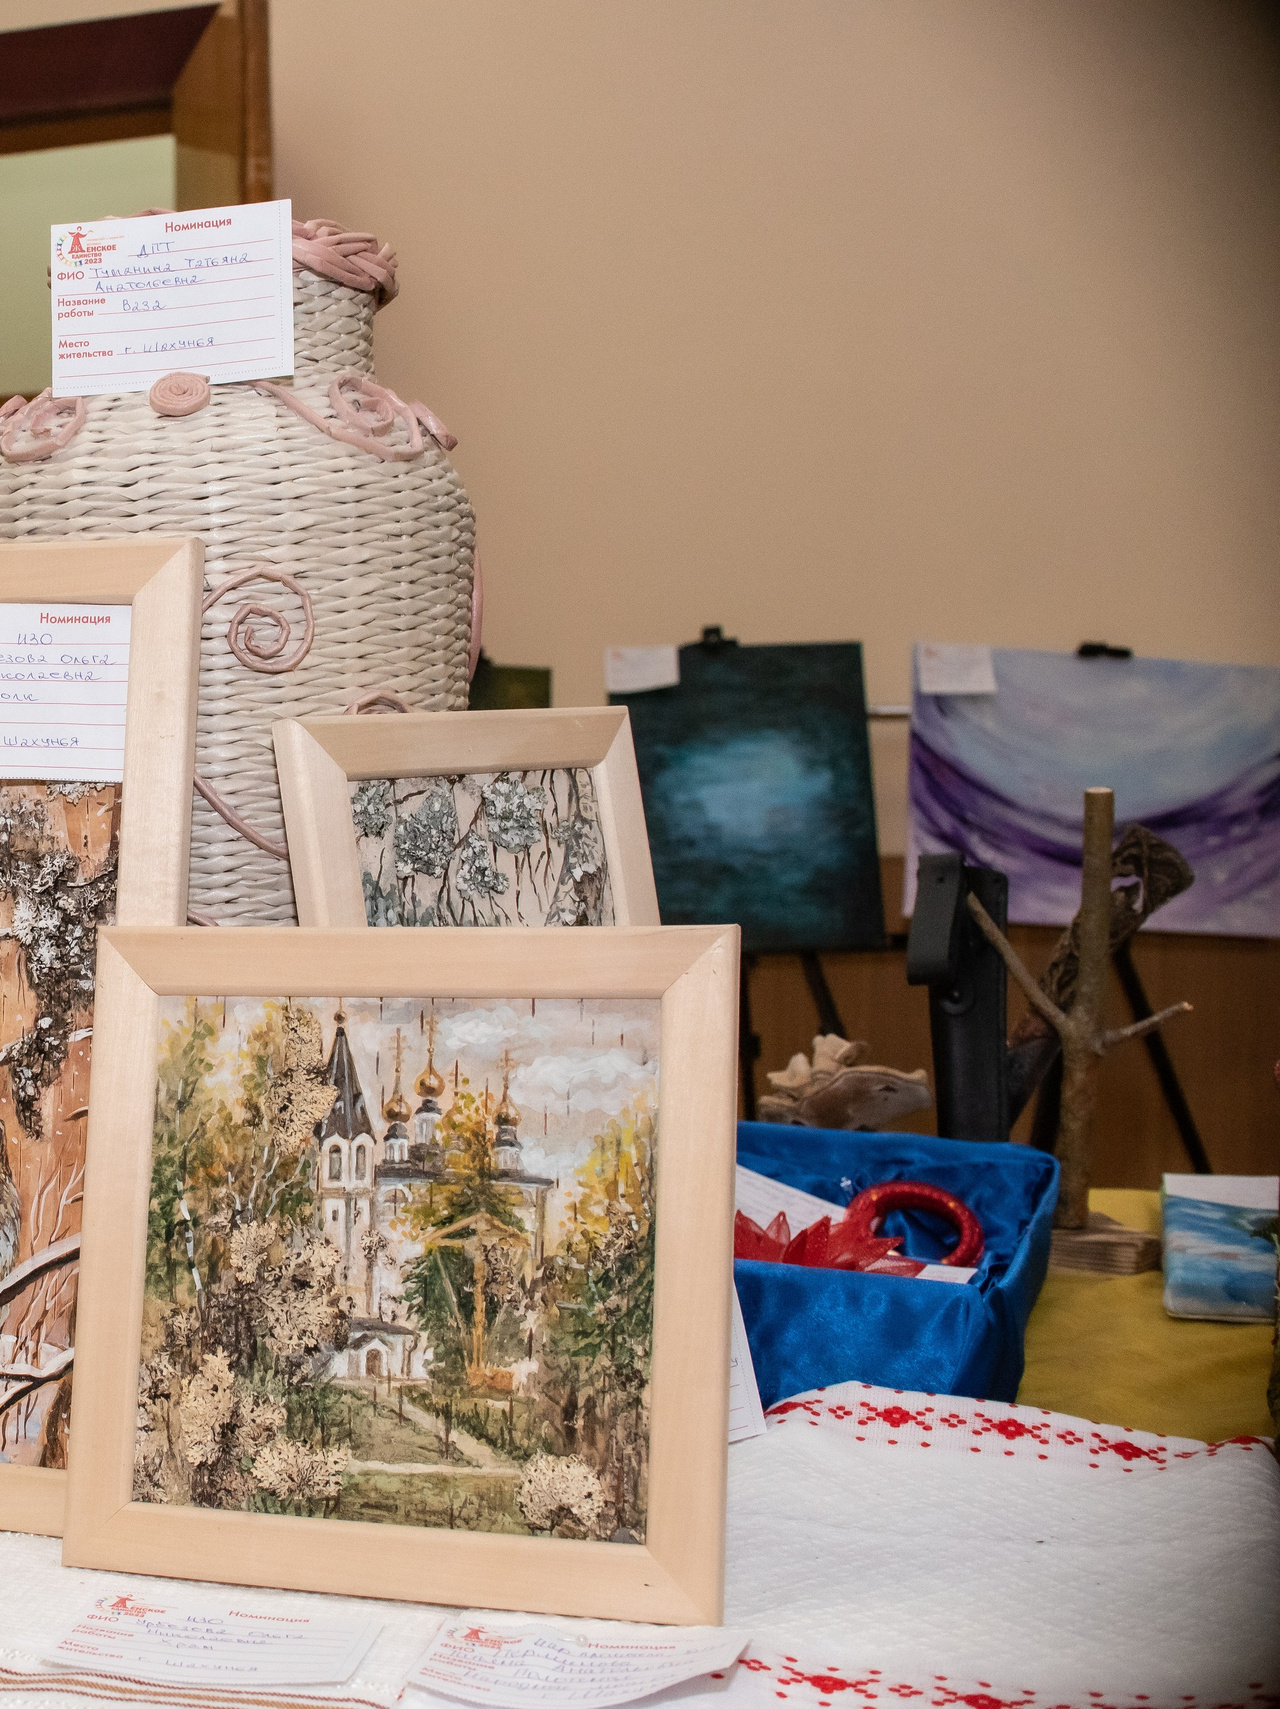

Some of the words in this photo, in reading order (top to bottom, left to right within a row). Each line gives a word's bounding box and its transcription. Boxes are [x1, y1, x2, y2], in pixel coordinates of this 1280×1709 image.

[165, 217, 232, 233] Номинация
[137, 241, 175, 258] ДПТ
[185, 253, 251, 268] Татьяна
[57, 271, 85, 280] ФИО
[57, 297, 106, 307] Название
[57, 309, 94, 321] работы
[58, 339, 90, 349] Место
[58, 349, 114, 360] жительства
[40, 613, 111, 625] Номинация
[17, 633, 53, 646] ИЗО
[60, 653, 116, 665] Ольга
[3, 736, 79, 748] Шахунья
[87, 1614, 120, 1623] ФИО
[228, 1610, 310, 1624] Номинация
[71, 1629, 116, 1640] работы
[77, 1624, 134, 1638] Название
[61, 1640, 99, 1651] Место
[440, 1642, 475, 1653] ФИО
[588, 1642, 676, 1650] Номинация
[56, 1645, 124, 1659] жительства
